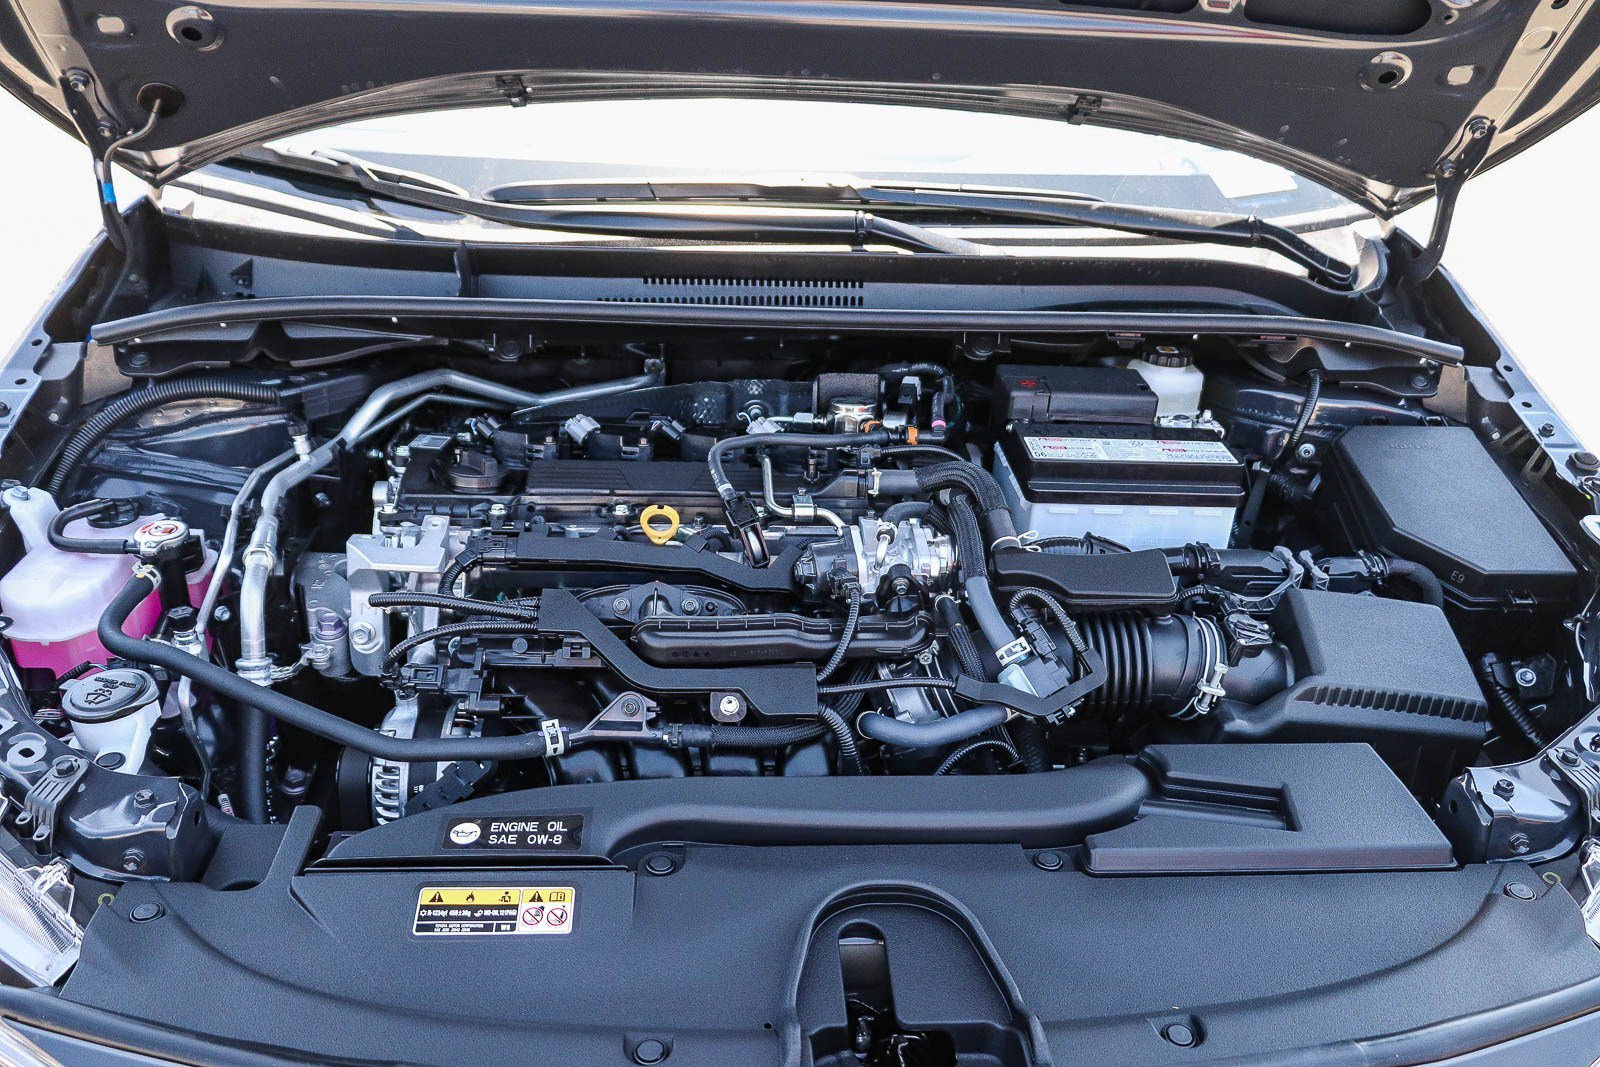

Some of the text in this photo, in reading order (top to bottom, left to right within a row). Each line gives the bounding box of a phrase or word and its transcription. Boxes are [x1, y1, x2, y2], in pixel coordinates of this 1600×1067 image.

[1450, 570, 1465, 584] E9
[490, 821, 568, 832] ENGINE OIL
[488, 834, 518, 845] SAE
